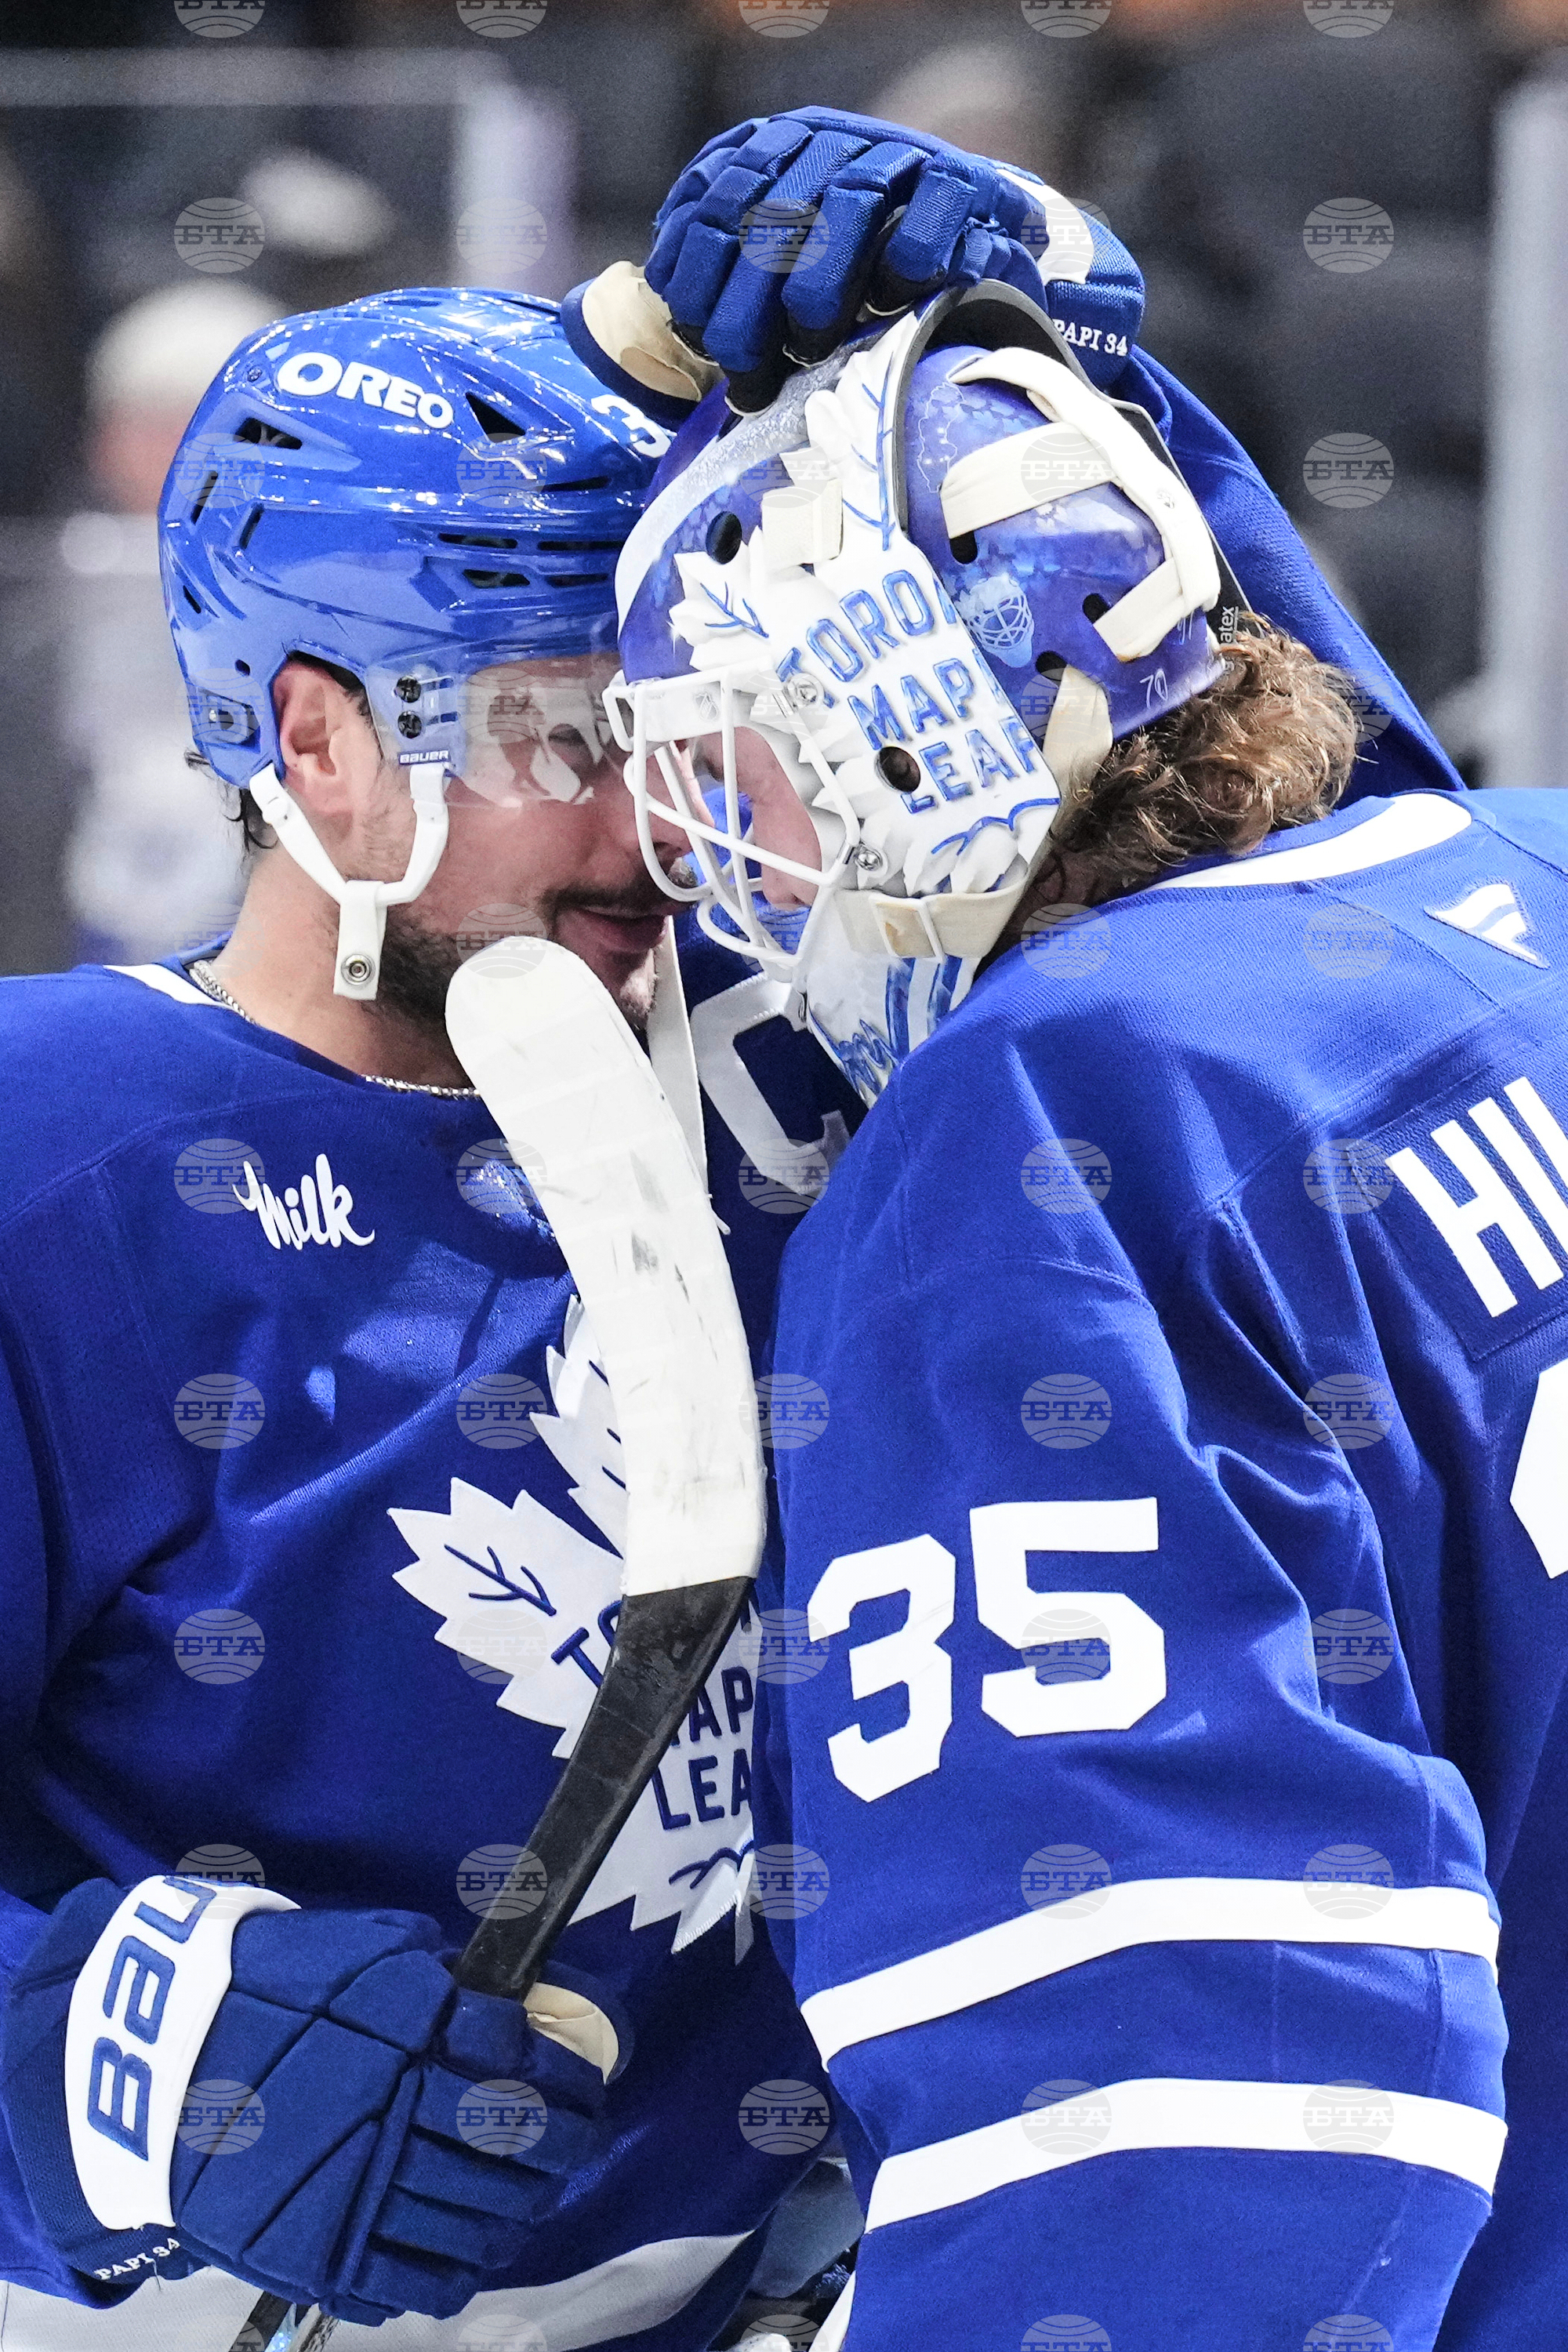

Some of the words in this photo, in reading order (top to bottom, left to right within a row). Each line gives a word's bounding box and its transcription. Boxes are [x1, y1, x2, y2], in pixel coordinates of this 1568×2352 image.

[1051, 318, 1102, 351] PAPI
[277, 352, 453, 430] OREO
[399, 750, 449, 764] BAUER
[808, 1497, 1167, 1803] 35
[93, 2252, 155, 2280] PAPI
